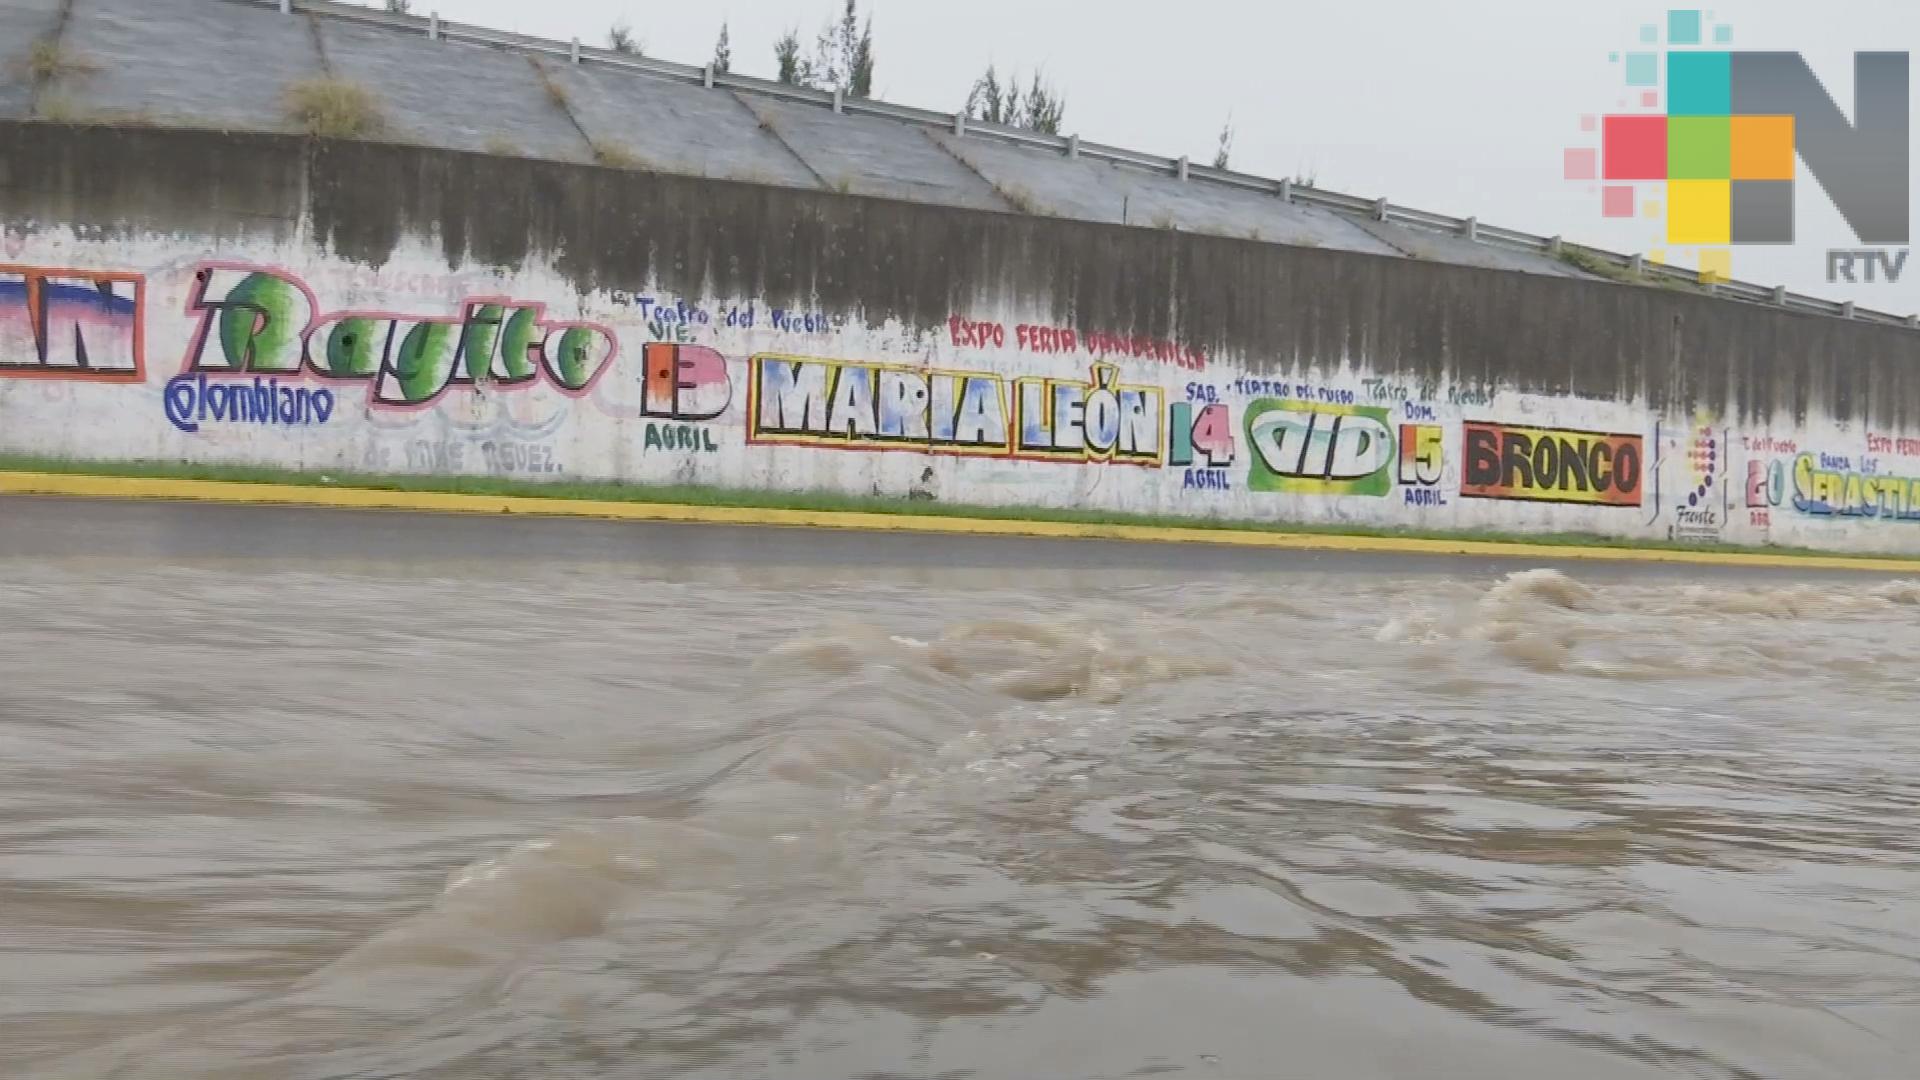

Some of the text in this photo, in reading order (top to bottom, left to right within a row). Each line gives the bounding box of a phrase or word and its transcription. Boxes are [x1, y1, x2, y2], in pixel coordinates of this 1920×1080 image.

[188, 264, 616, 406] Rayito
[635, 296, 709, 327] Teatro
[726, 305, 756, 328] del
[947, 314, 1005, 350] EXPO
[1170, 402, 1236, 467] 14
[1399, 424, 1443, 486] 15
[1466, 429, 1640, 494] BRONCO
